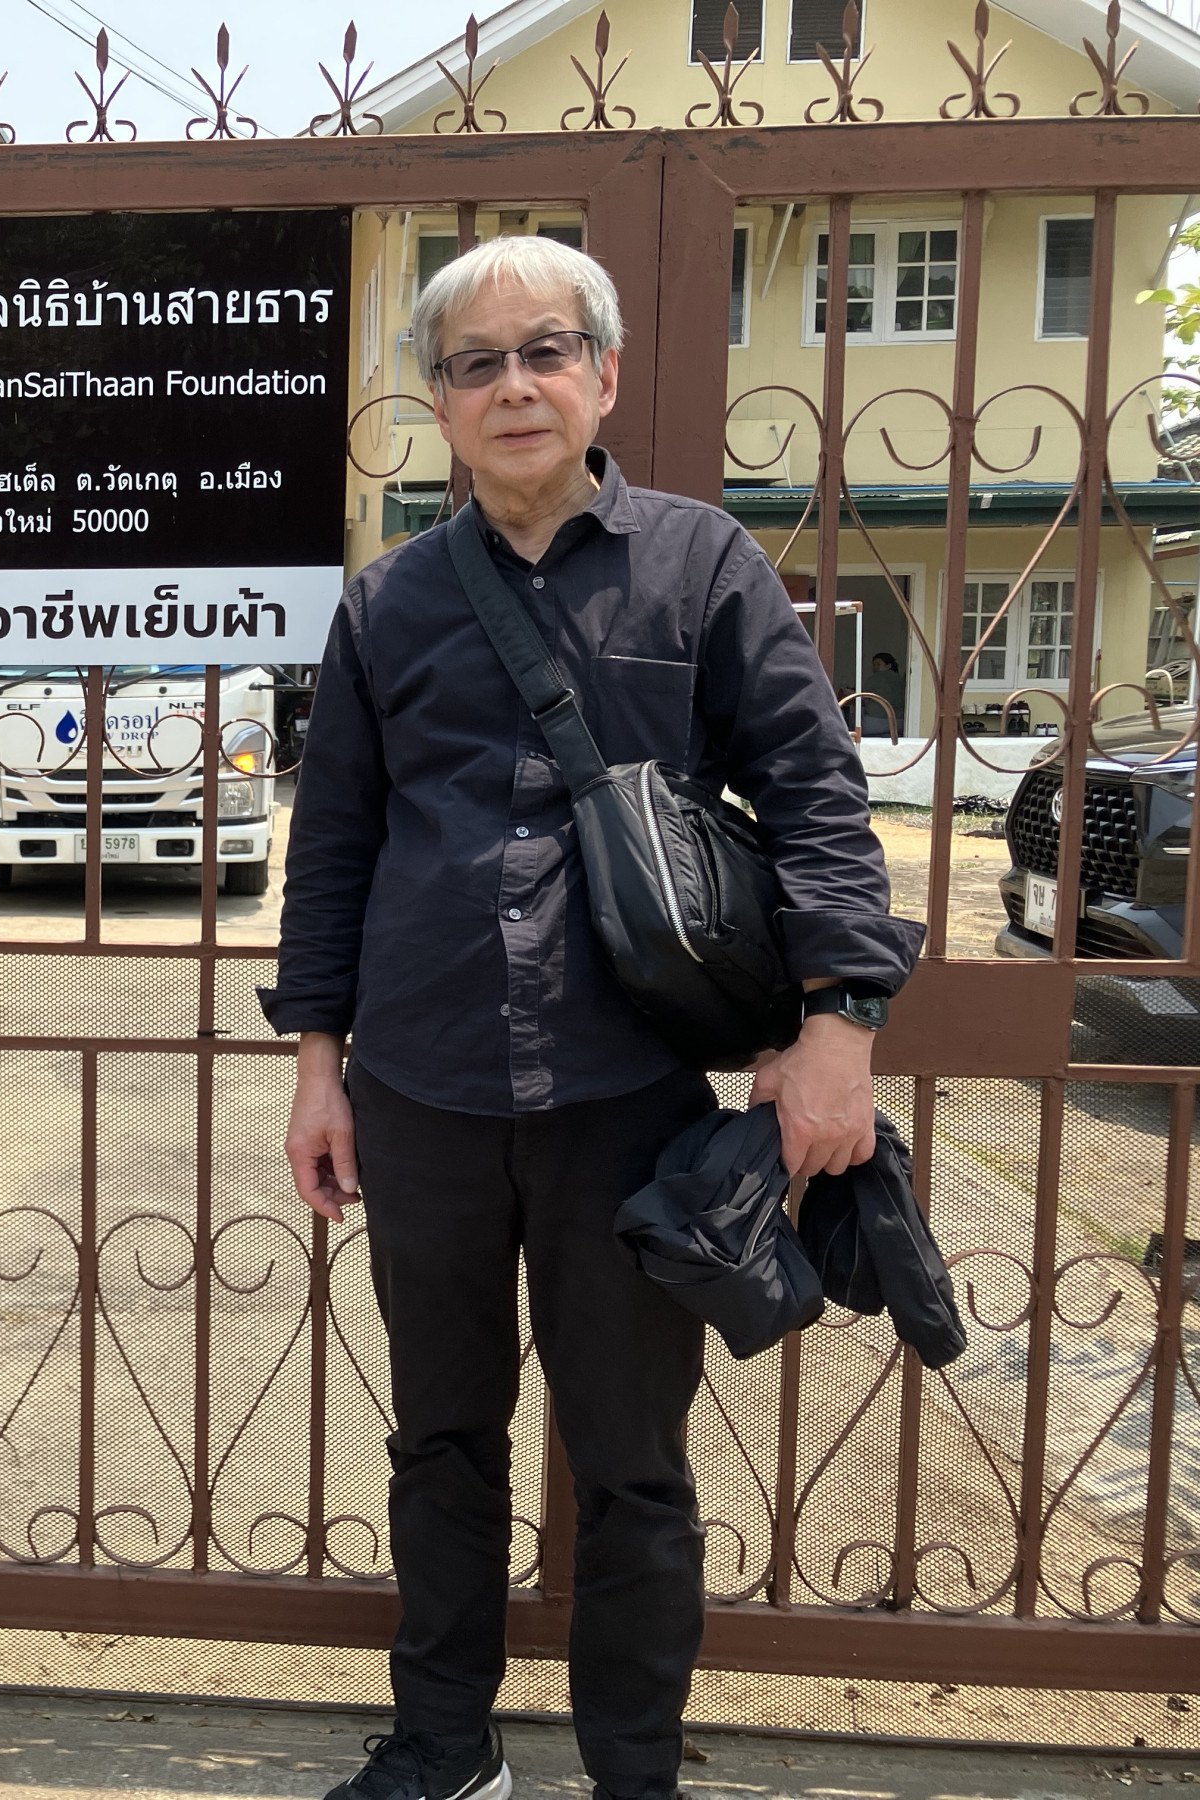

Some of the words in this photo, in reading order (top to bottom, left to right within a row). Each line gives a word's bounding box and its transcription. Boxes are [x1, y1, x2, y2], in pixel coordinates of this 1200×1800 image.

[166, 368, 326, 396] Foundation
[76, 464, 178, 498] ต.วัดเกตุ
[200, 461, 282, 490] อ.เมือง
[72, 508, 149, 533] 50000
[6, 703, 41, 711] ELF
[105, 838, 136, 850] 5978
